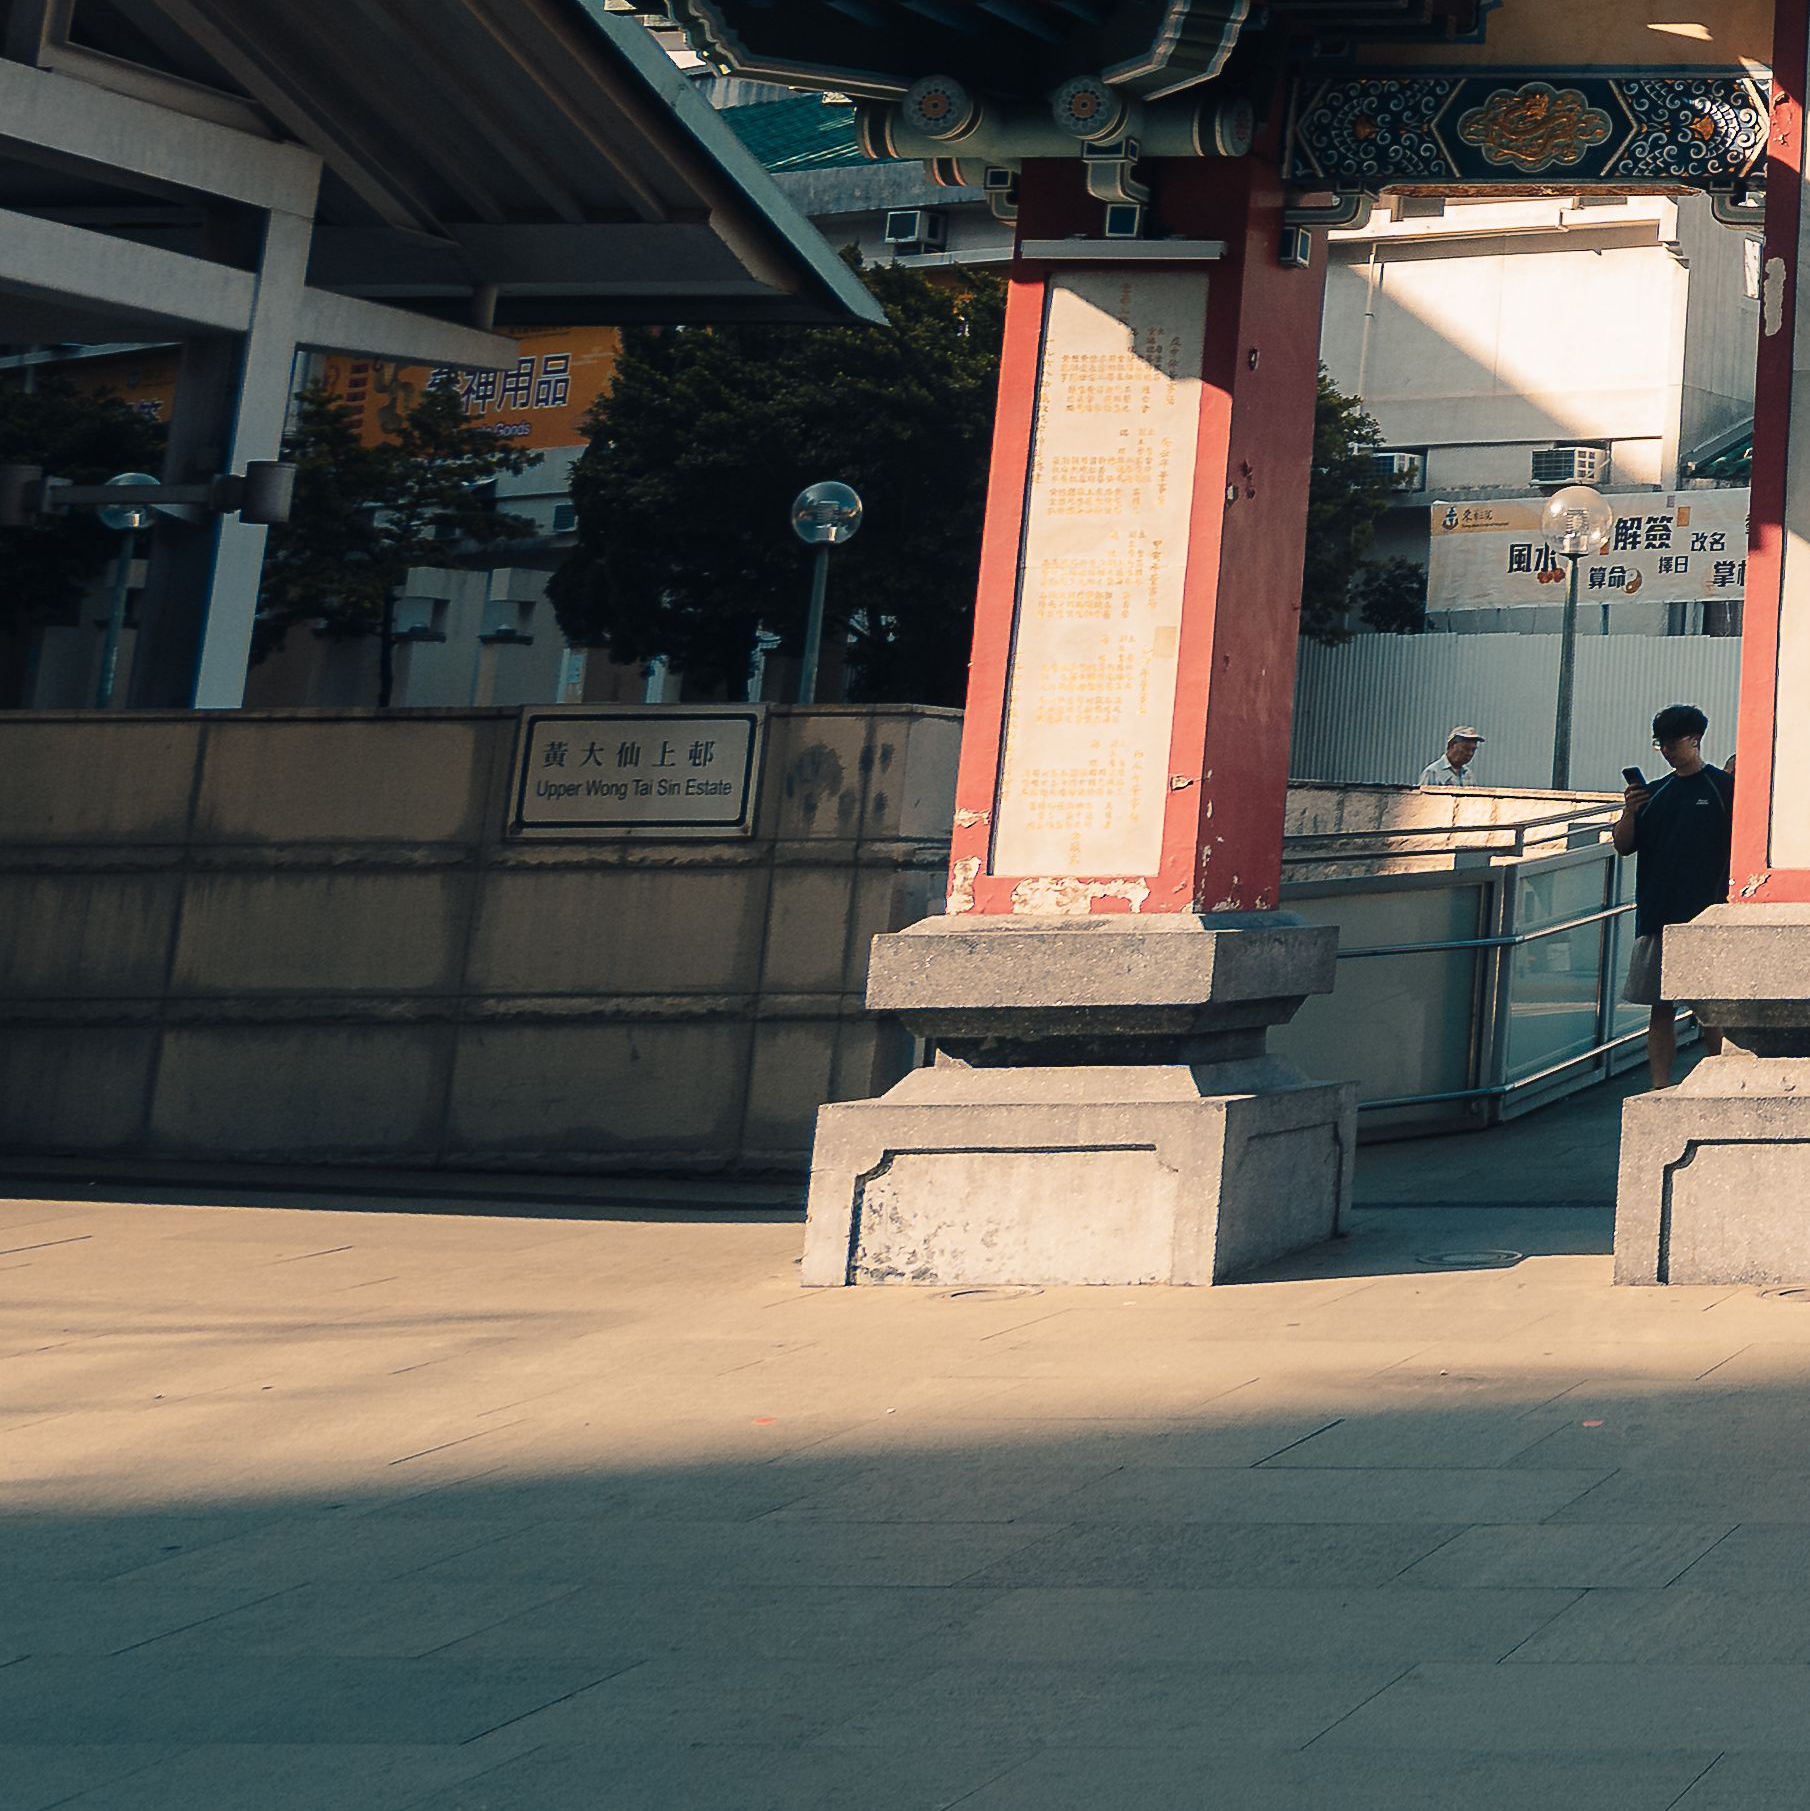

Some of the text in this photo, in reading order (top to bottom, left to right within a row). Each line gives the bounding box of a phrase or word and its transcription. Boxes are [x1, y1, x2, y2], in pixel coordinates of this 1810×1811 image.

[1691, 532, 1726, 552] 改名
[1658, 555, 1689, 574] 擇日
[1588, 566, 1627, 589] 算命
[543, 740, 715, 768] 黃大仙上邨
[536, 778, 733, 800] Upper Wong Tai Sin Estate
